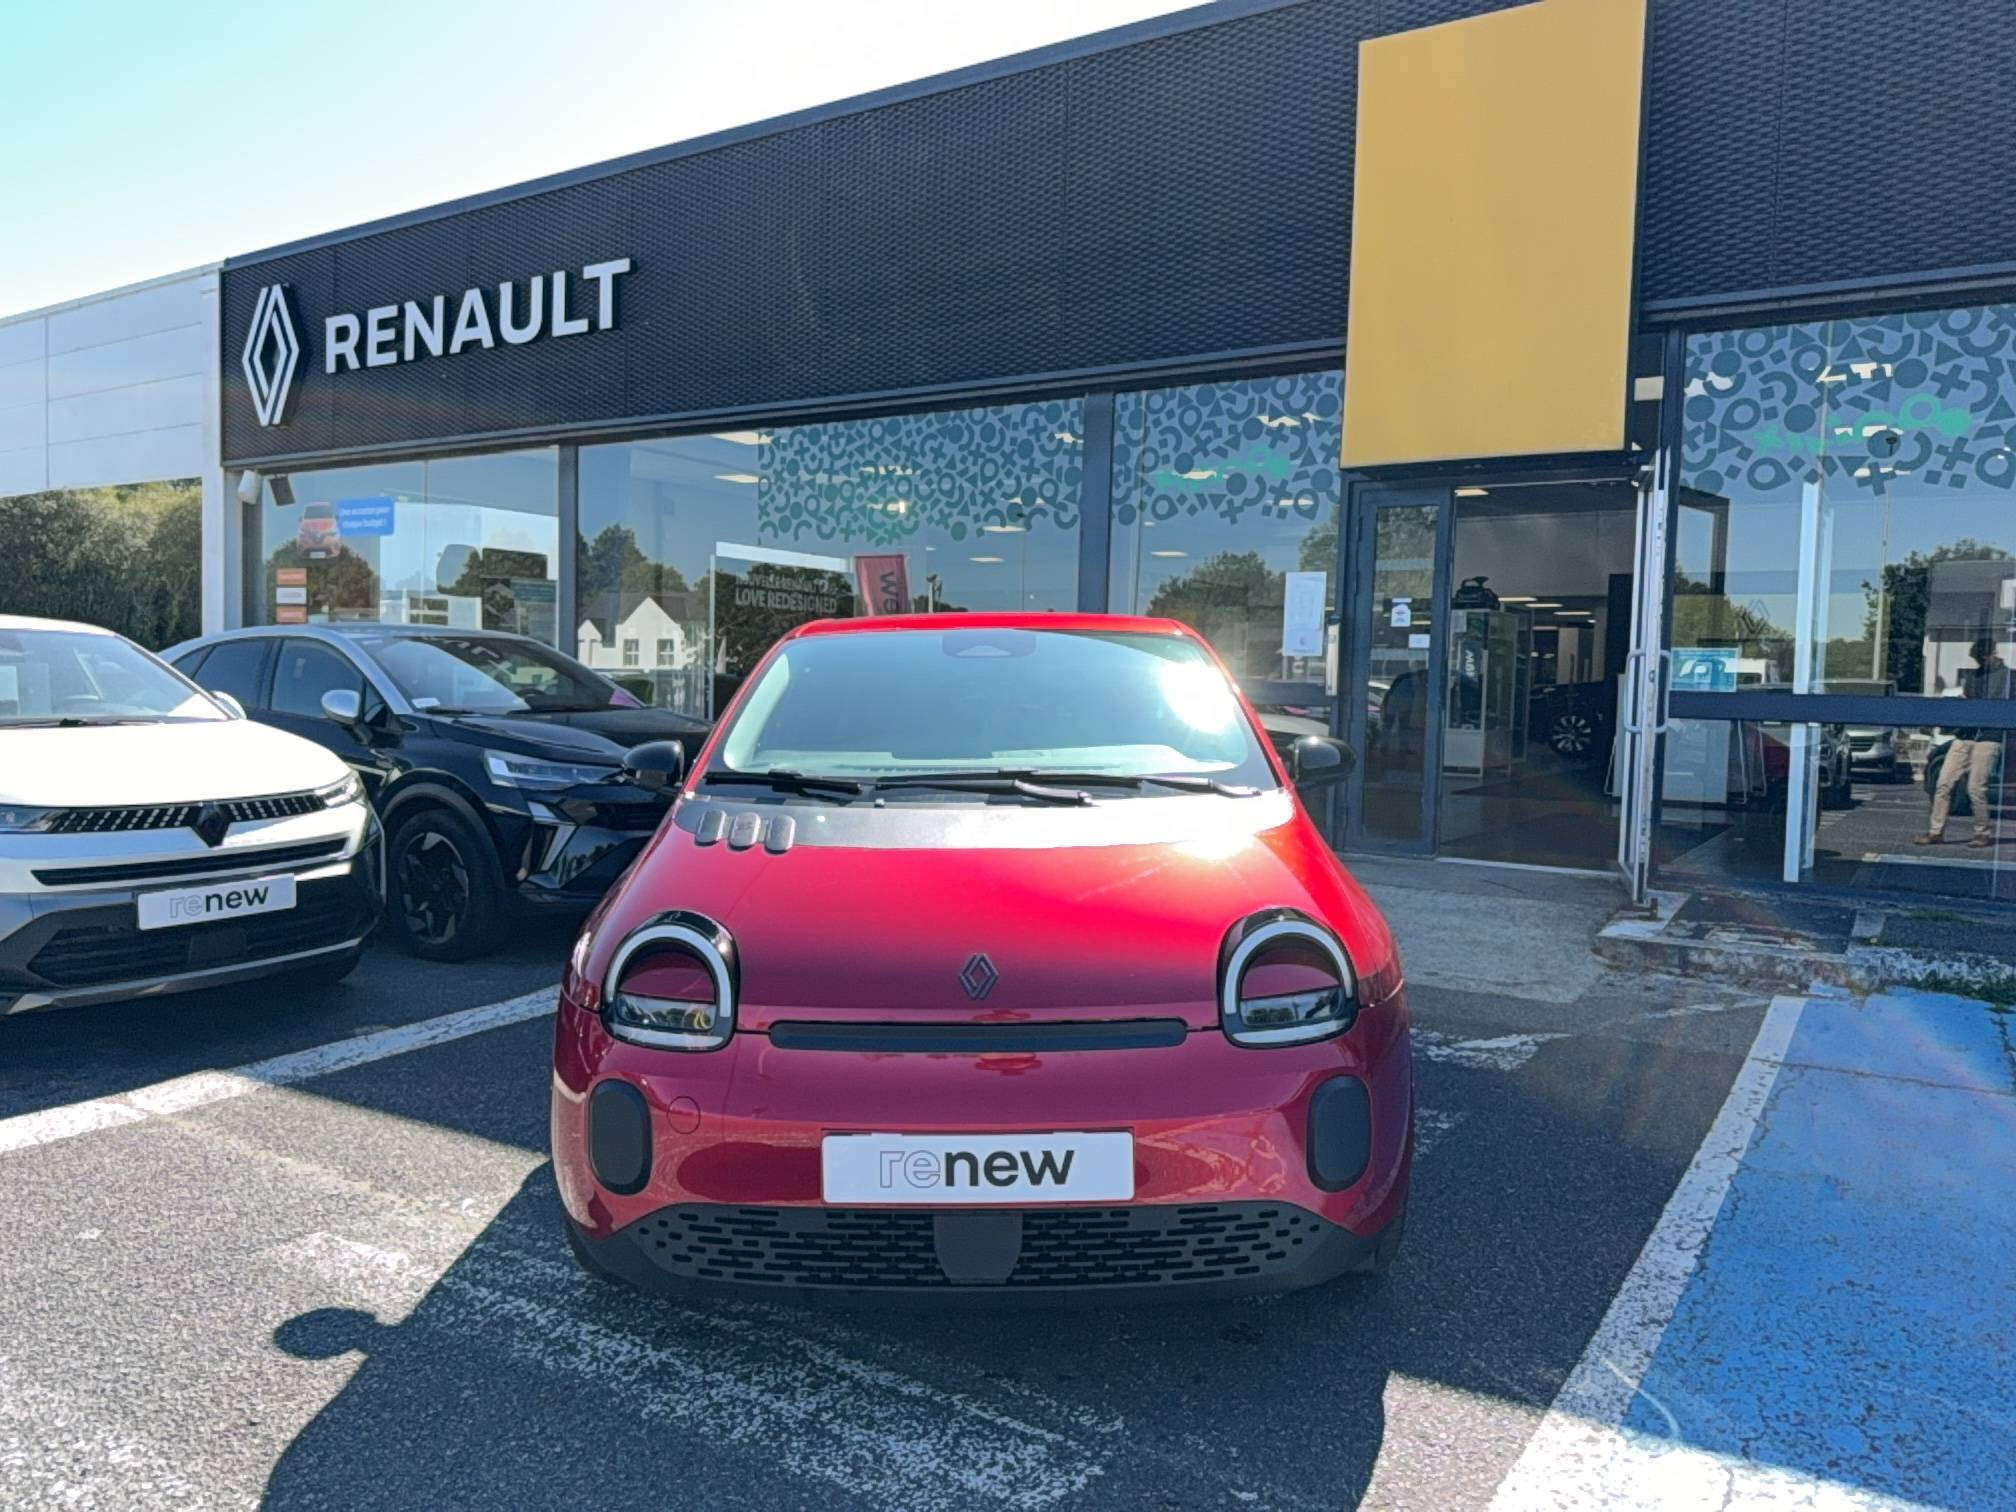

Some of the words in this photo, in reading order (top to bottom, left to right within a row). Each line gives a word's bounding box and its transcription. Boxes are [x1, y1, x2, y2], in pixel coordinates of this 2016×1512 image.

[325, 257, 631, 374] RENAULT
[735, 587, 766, 608] LOVE
[767, 590, 837, 614] REDESIGNED
[169, 886, 269, 919] renew
[879, 1149, 1075, 1189] renew
